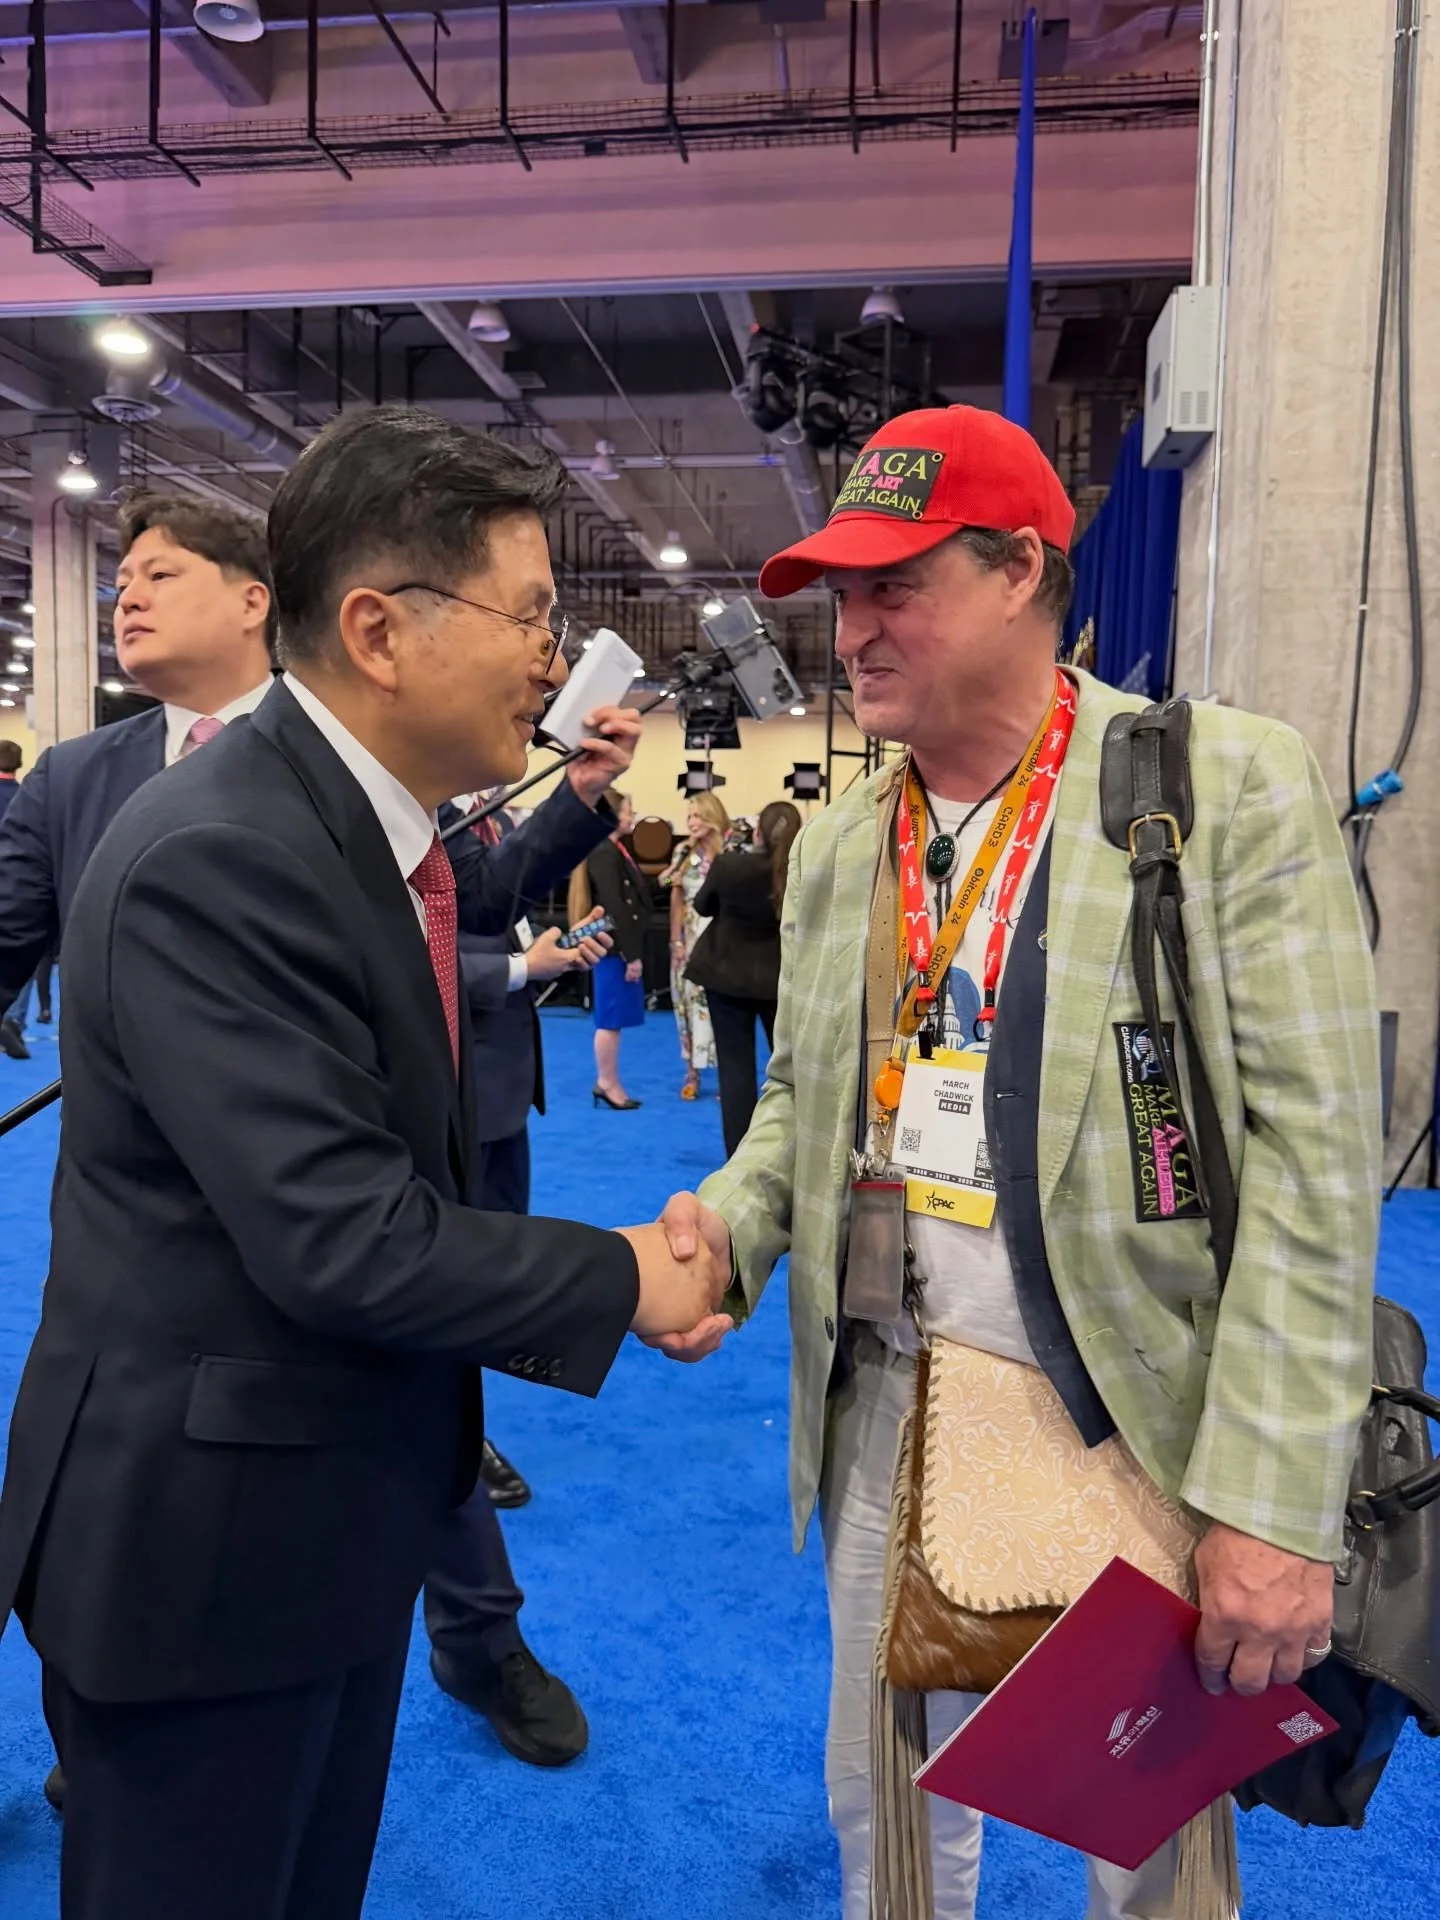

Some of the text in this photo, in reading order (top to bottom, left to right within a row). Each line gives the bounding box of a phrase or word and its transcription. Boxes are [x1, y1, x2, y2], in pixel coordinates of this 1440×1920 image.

[871, 475, 904, 490] ART
[836, 489, 921, 512] EAT AGAIN
[1018, 775, 1029, 788] 24
[911, 804, 920, 815] 24
[988, 806, 1014, 847] CARD3
[951, 912, 962, 925] 24
[942, 1079, 970, 1090] MARCH
[934, 1089, 974, 1102] CHADWICK
[940, 1102, 969, 1113] MEDIA
[1143, 1084, 1162, 1127] MAKE
[1129, 1083, 1159, 1215] GREAT AGAIN
[929, 1193, 955, 1211] CPAC
